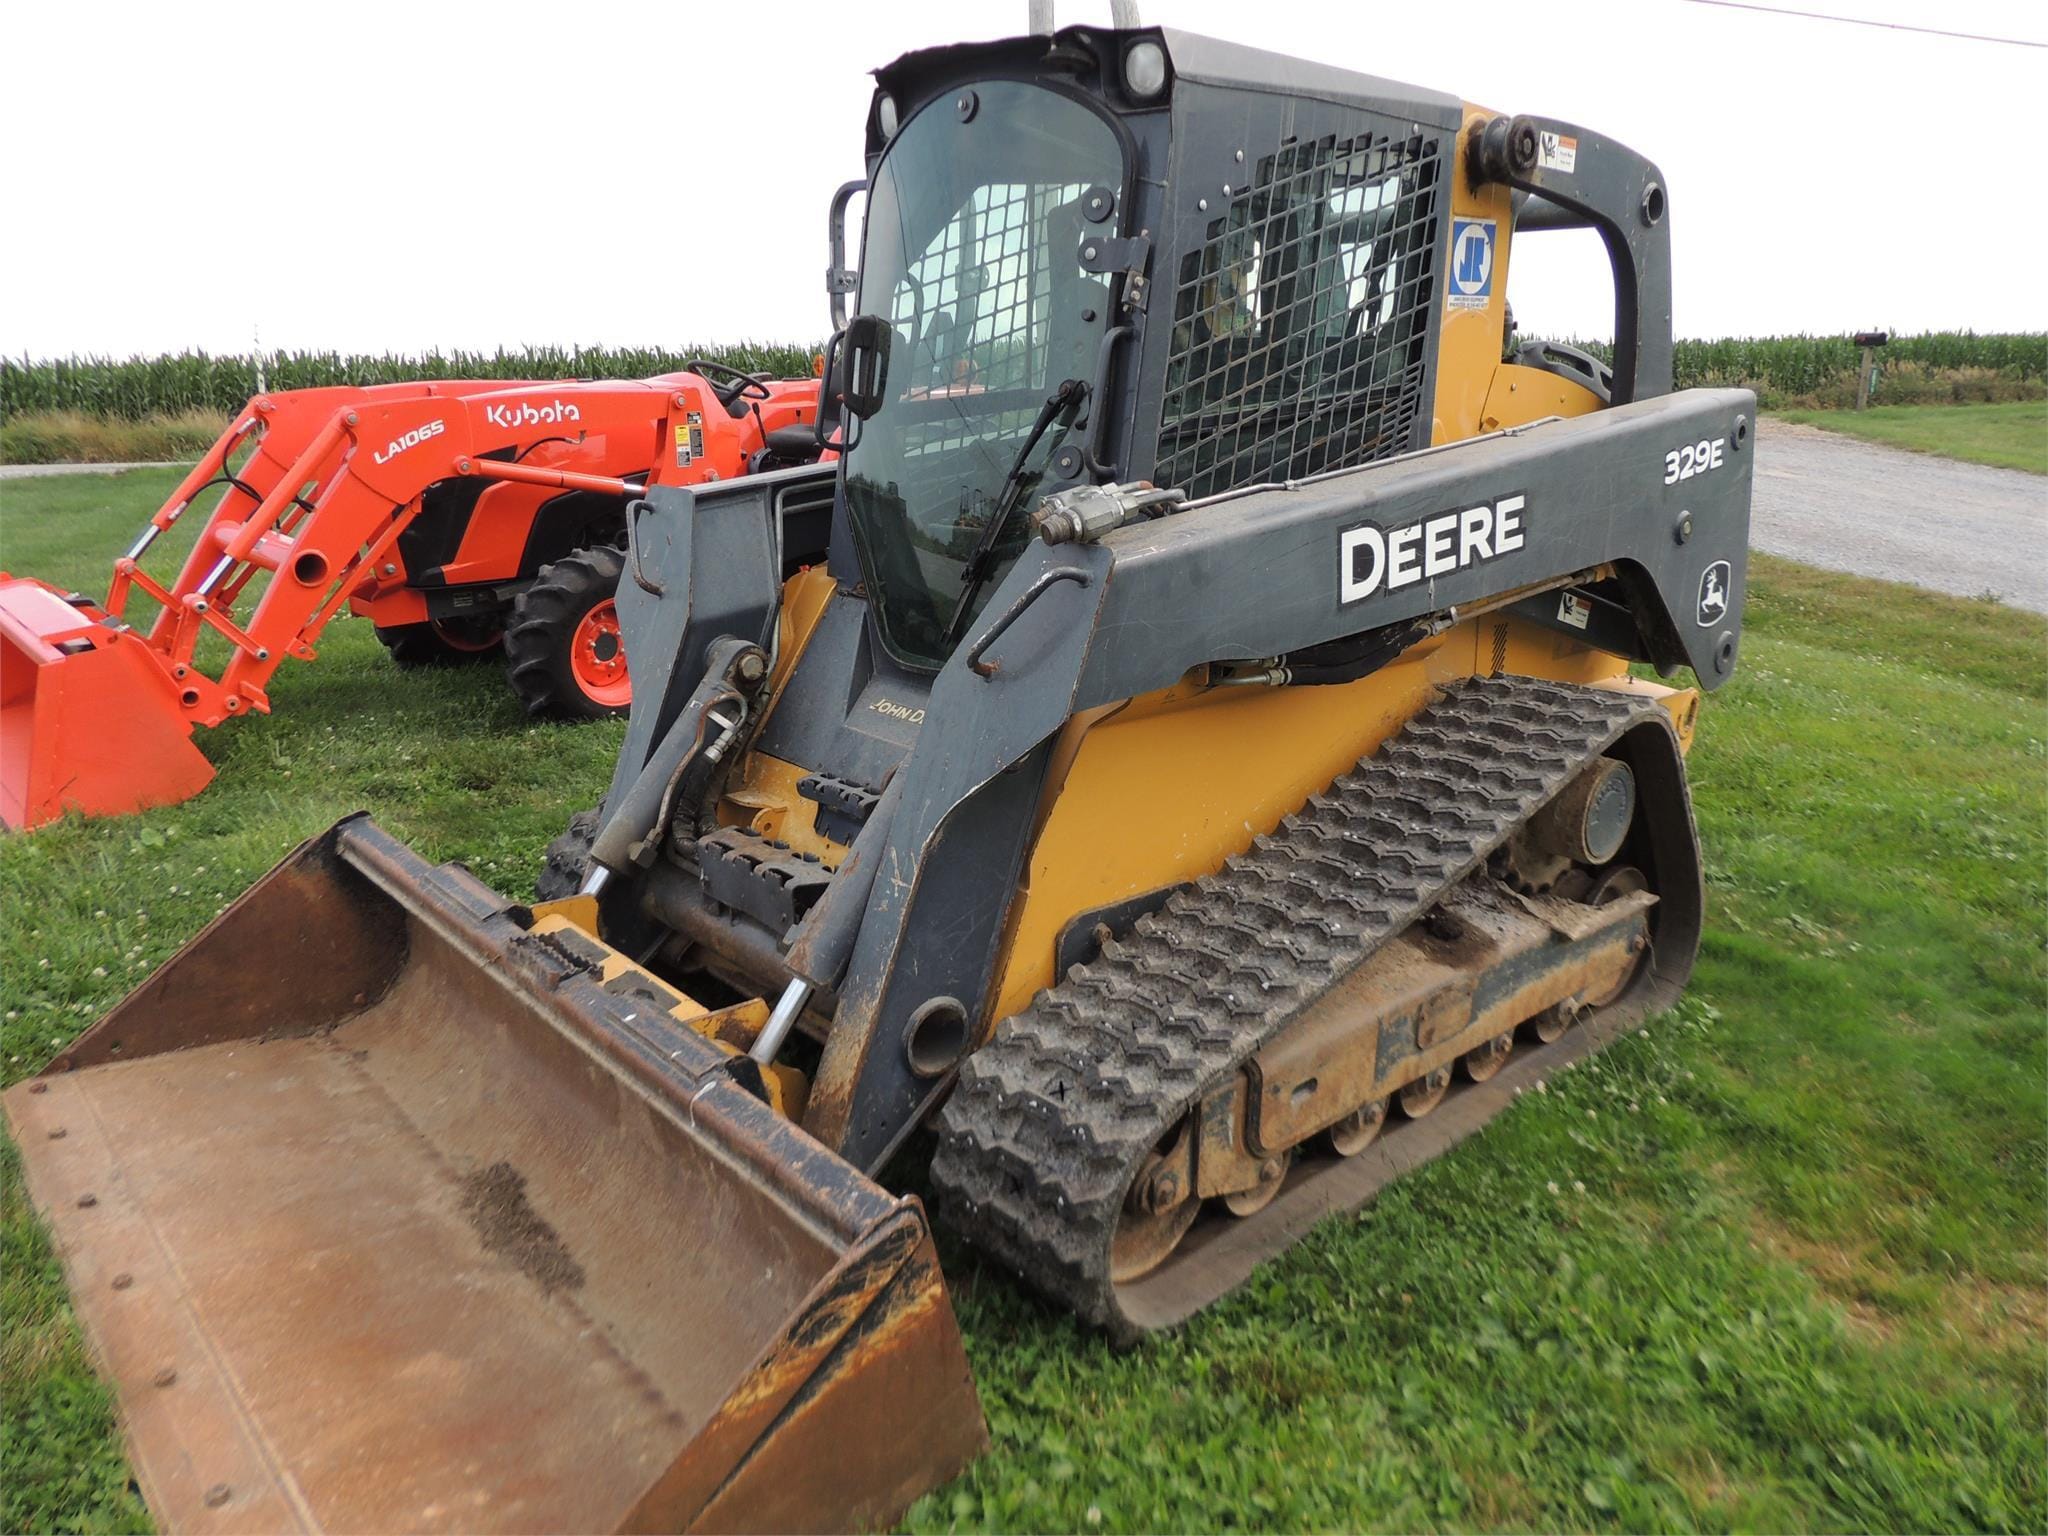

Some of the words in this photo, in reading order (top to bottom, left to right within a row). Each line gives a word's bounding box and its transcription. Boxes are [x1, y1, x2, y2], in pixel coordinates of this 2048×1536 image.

[486, 400, 580, 427] Kubota
[373, 419, 445, 465] LA1065
[1664, 438, 1725, 485] 329E
[1341, 495, 1525, 604] DEERE
[869, 699, 912, 719] JOHN
